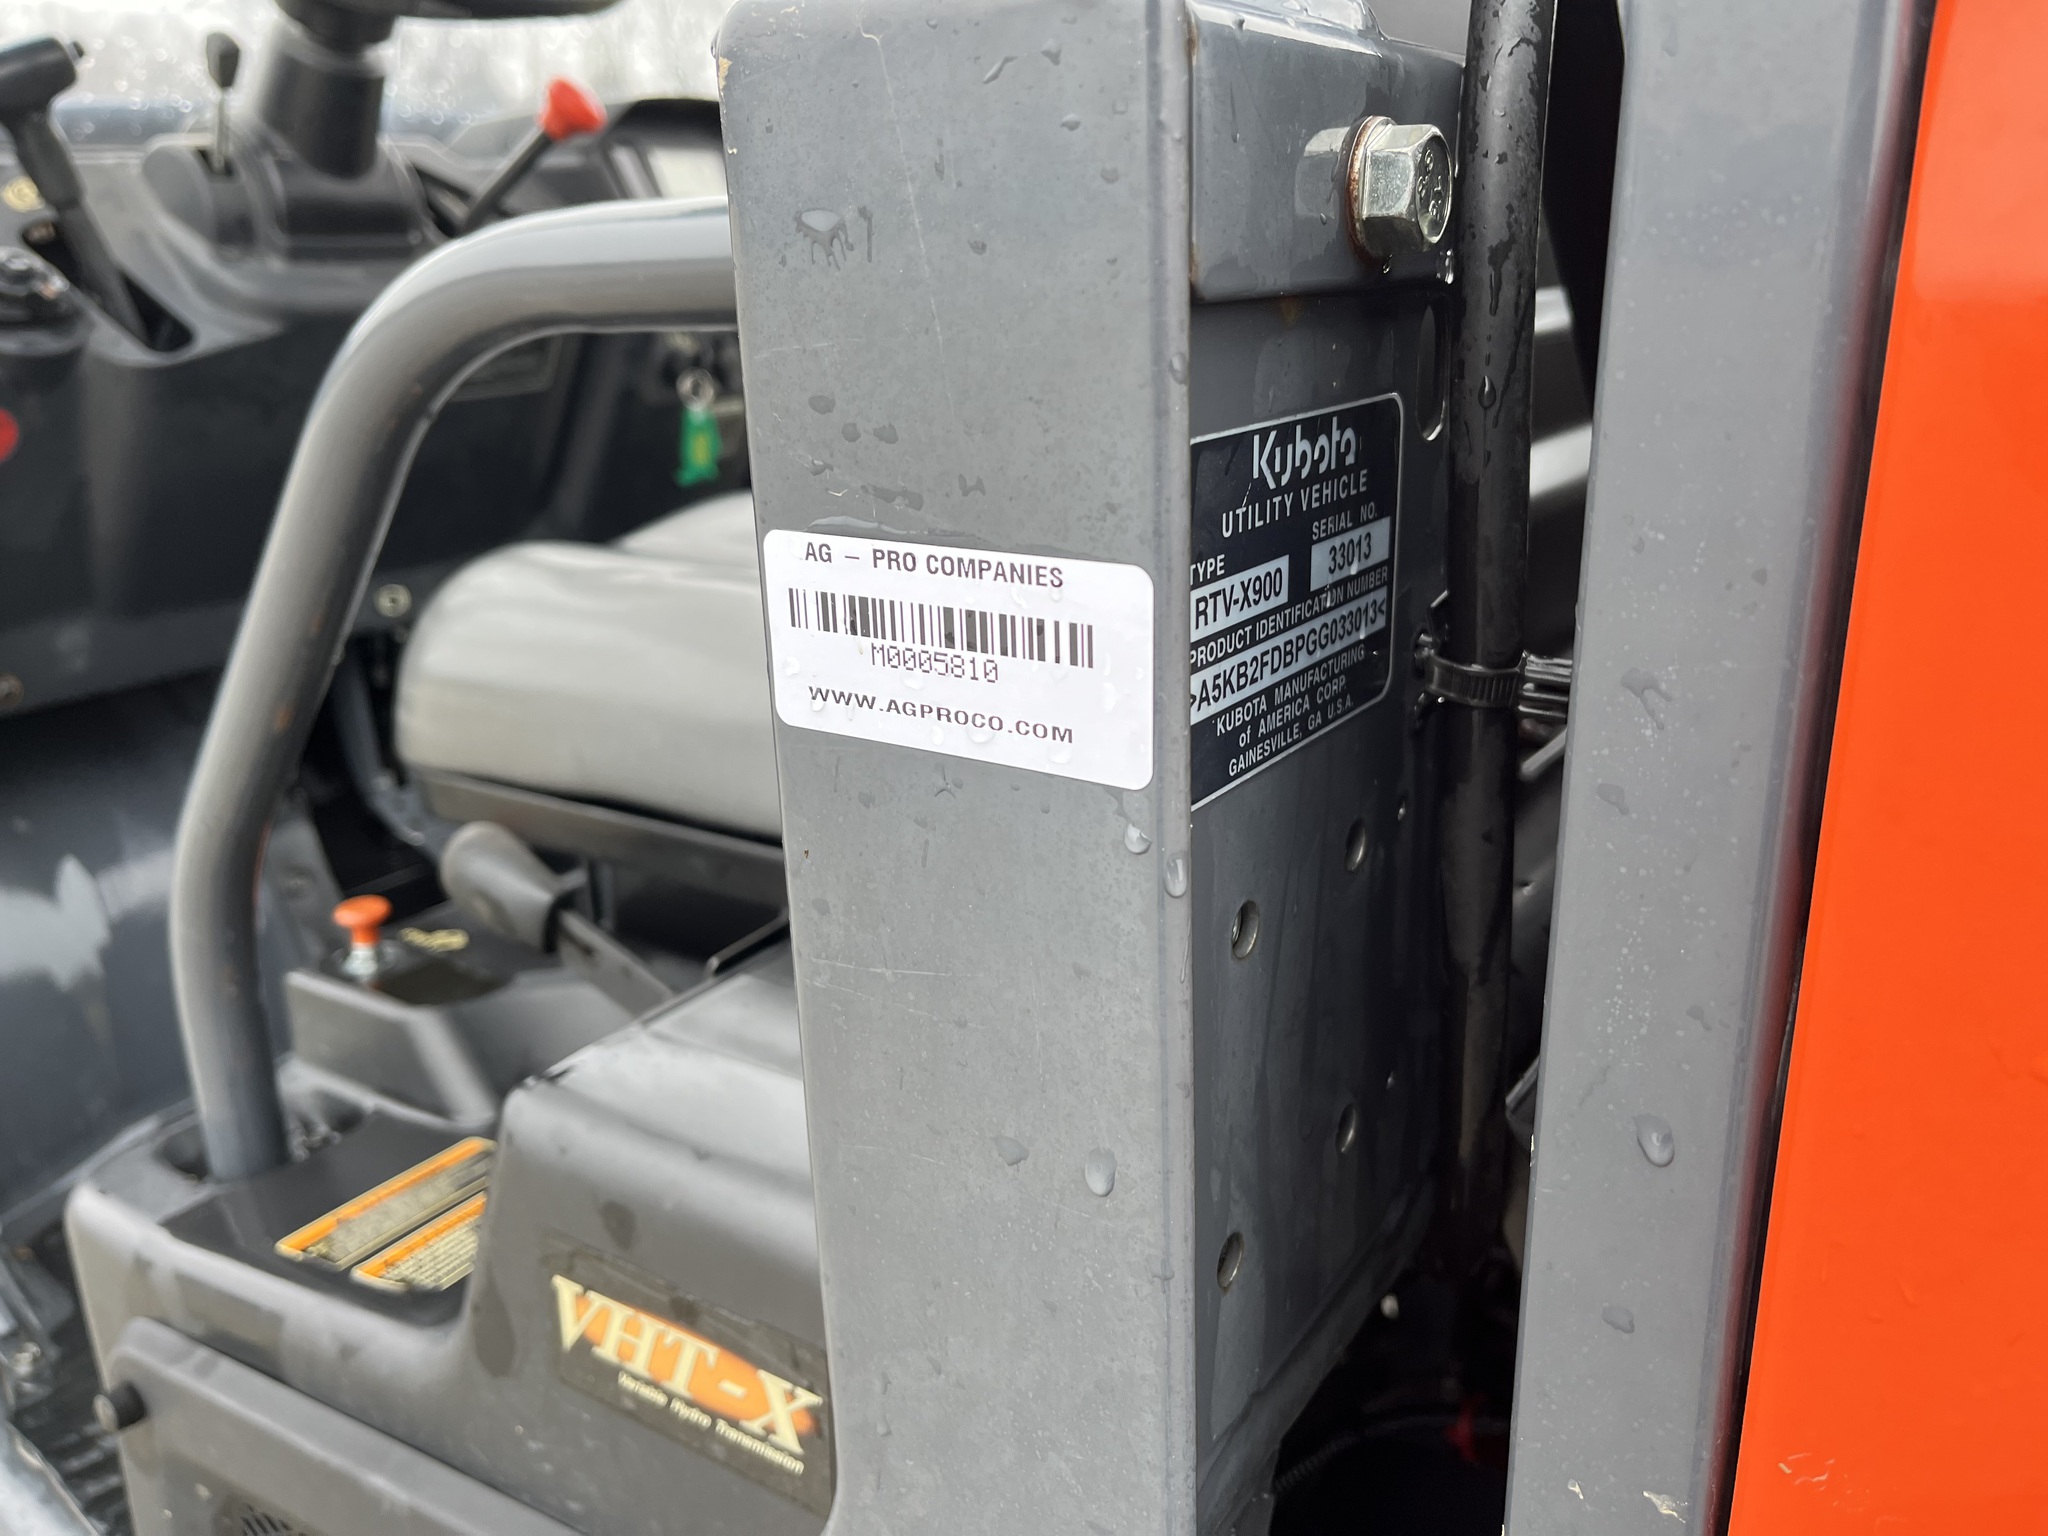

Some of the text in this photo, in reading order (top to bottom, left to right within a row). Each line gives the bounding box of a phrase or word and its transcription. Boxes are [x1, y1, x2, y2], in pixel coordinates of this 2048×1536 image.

[1253, 416, 1356, 490] Kubota
[1222, 469, 1368, 538] UTILITY VEHICLE
[1312, 501, 1378, 540] SERIAL NO.
[804, 541, 833, 564] AG
[872, 549, 917, 573] PRO
[926, 554, 1064, 588] COMPANIES
[1190, 553, 1225, 586] TYPE
[1328, 531, 1372, 575] 33013
[1190, 565, 1388, 668] PRODUCT IDENTIFICATION NUMBER
[1195, 567, 1283, 630] RTV-X900
[871, 642, 999, 684] M0005810
[1216, 643, 1365, 737] KUBOTA MANUFACTURING
[808, 686, 1074, 745] WWW.AGPROCO.COM
[1228, 692, 1354, 777] GAINESVILLE, GA U.S.A.
[1239, 674, 1347, 748] of AMERICA CORP.
[551, 1274, 823, 1456] VHT-X
